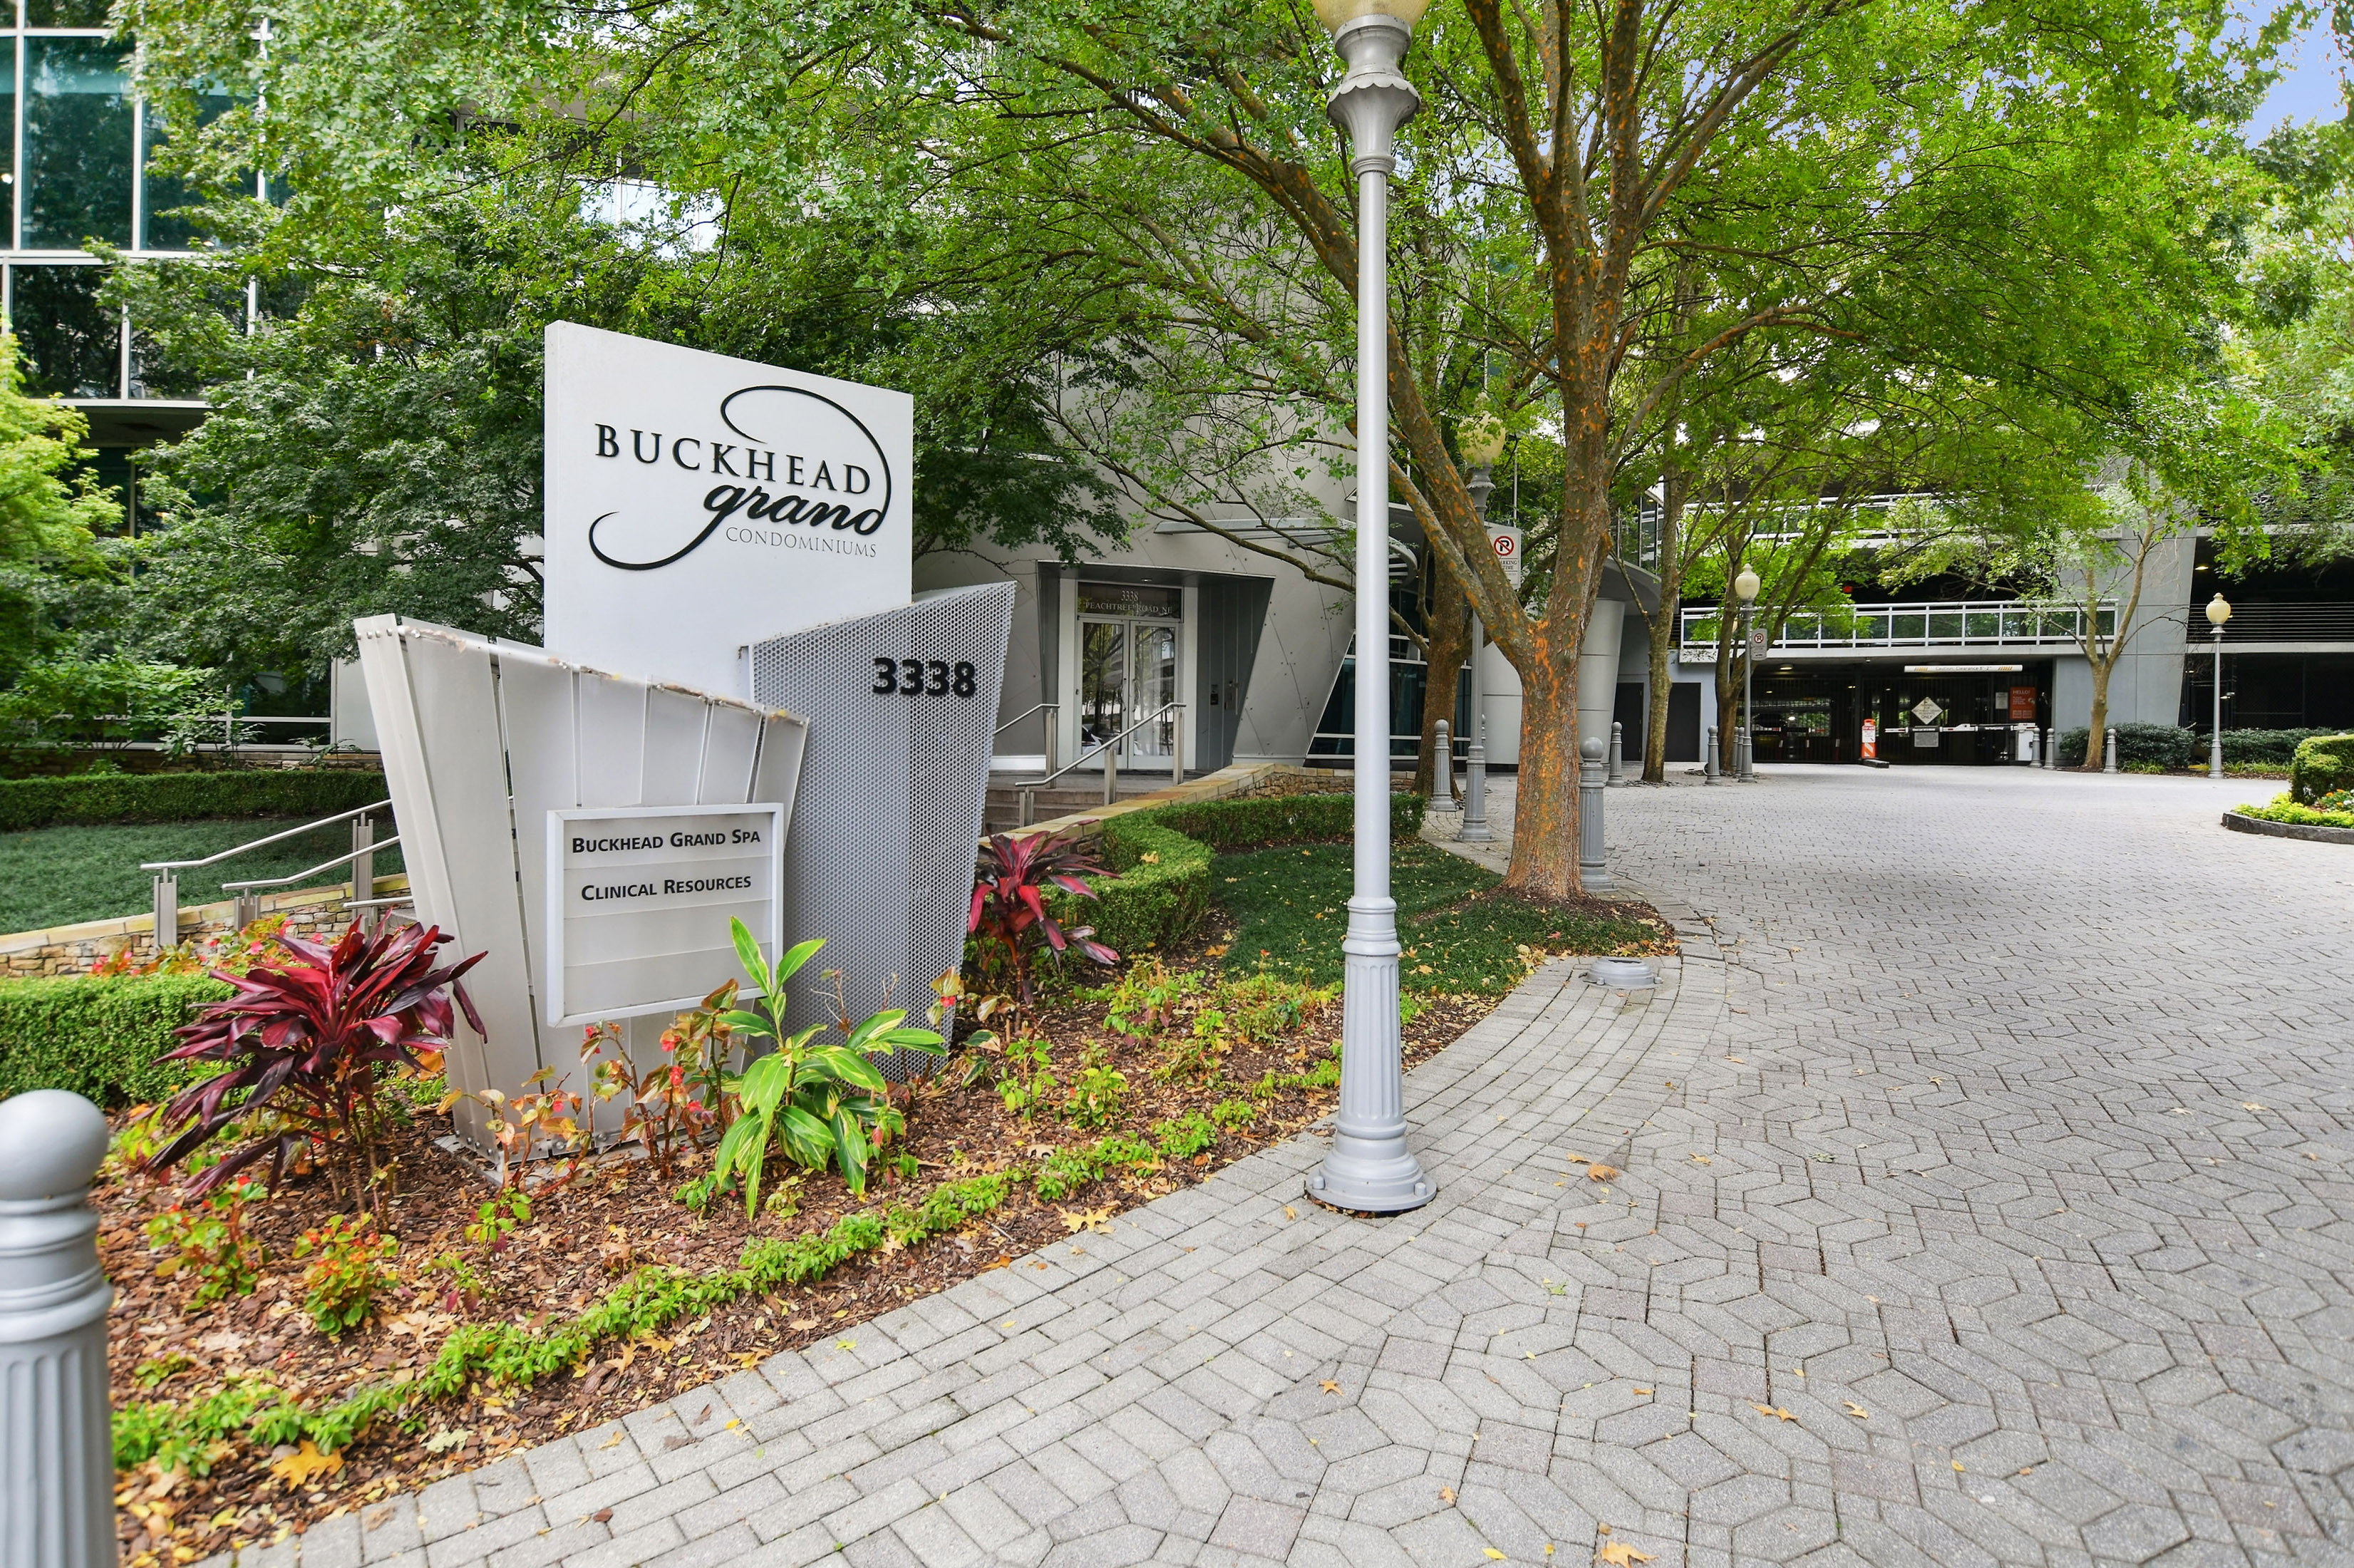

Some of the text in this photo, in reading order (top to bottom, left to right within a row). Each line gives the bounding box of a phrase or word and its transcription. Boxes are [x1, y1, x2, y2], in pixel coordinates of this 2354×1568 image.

[594, 423, 871, 495] BUCKHEAD
[726, 527, 877, 557] CONDOMINIUMS
[1085, 602, 1132, 611] PEACHTREE
[1135, 604, 1159, 613] ROAD
[1121, 590, 1139, 602] 3338
[873, 657, 977, 698] 3338
[572, 828, 761, 853] BUCKHEAD GRAND SPA
[581, 875, 752, 901] CLINICAL RESOURCES
